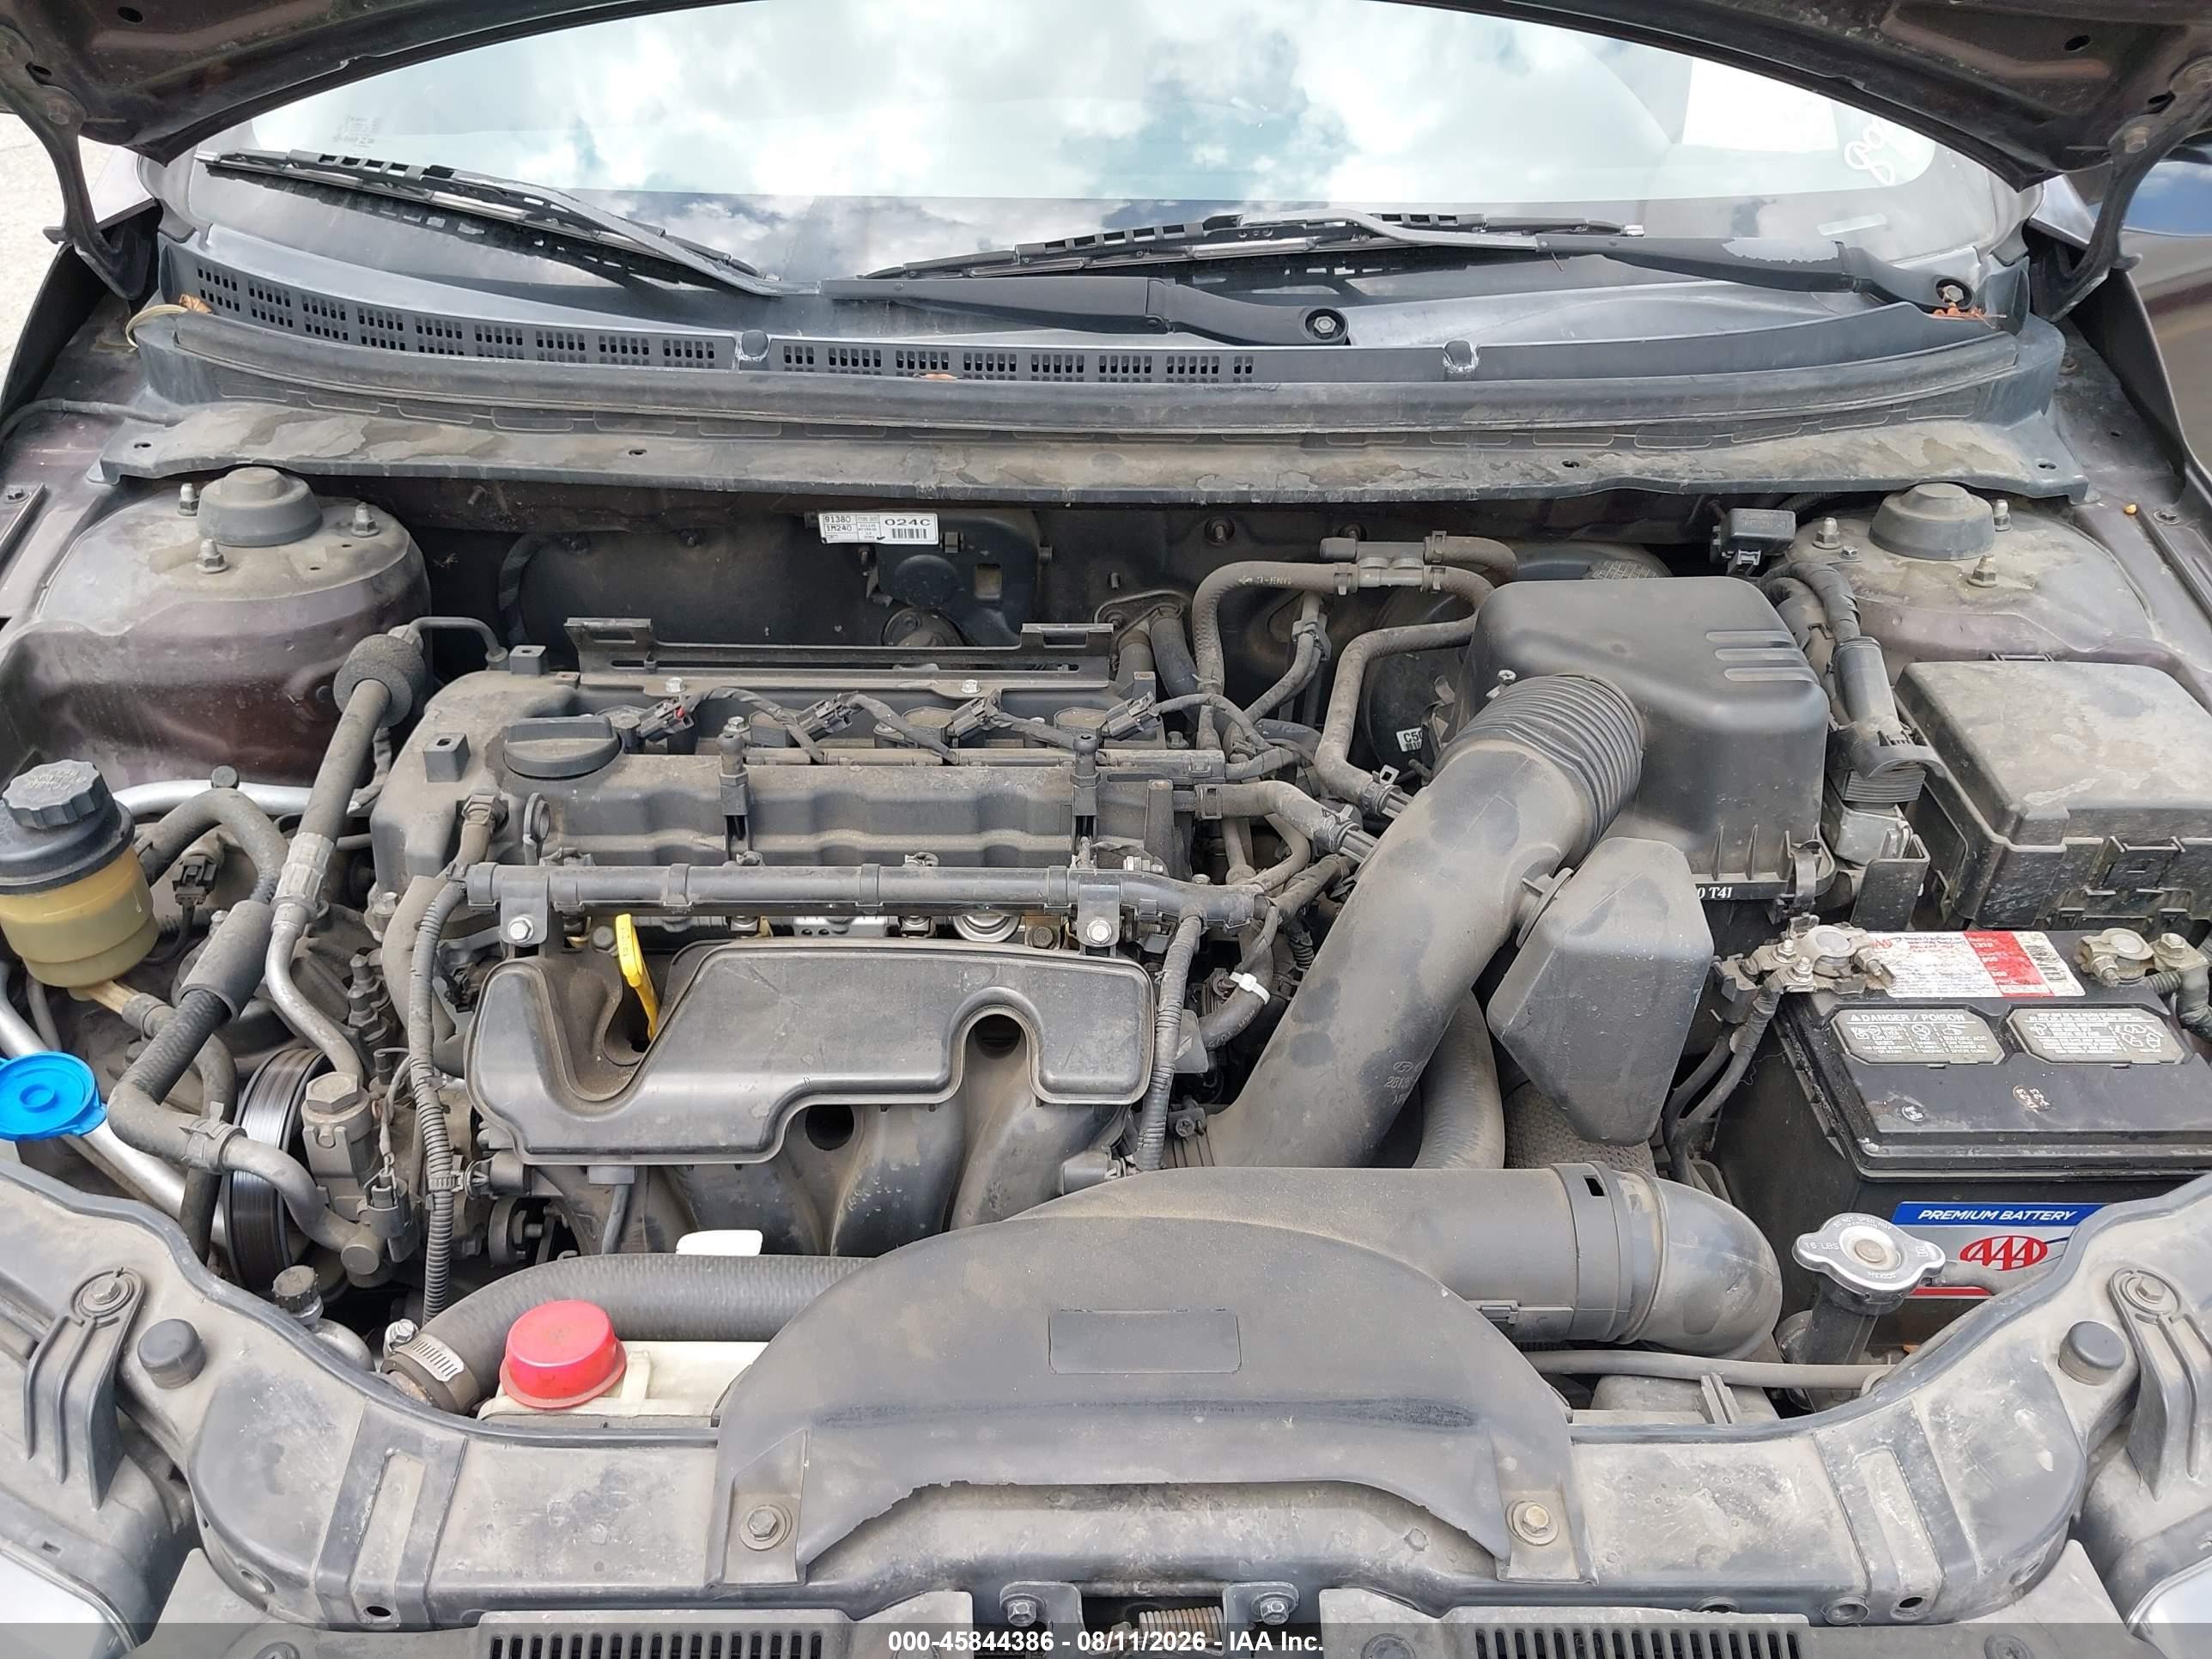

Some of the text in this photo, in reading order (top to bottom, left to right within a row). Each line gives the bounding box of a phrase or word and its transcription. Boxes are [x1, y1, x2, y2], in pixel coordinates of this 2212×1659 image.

[824, 515, 852, 524] 91380
[1709, 886, 1733, 899] T41
[1922, 1013, 1966, 1022] POISON
[1917, 1209, 2078, 1221] PREMIUM BATTERY
[1960, 1235, 2049, 1272] AAA
